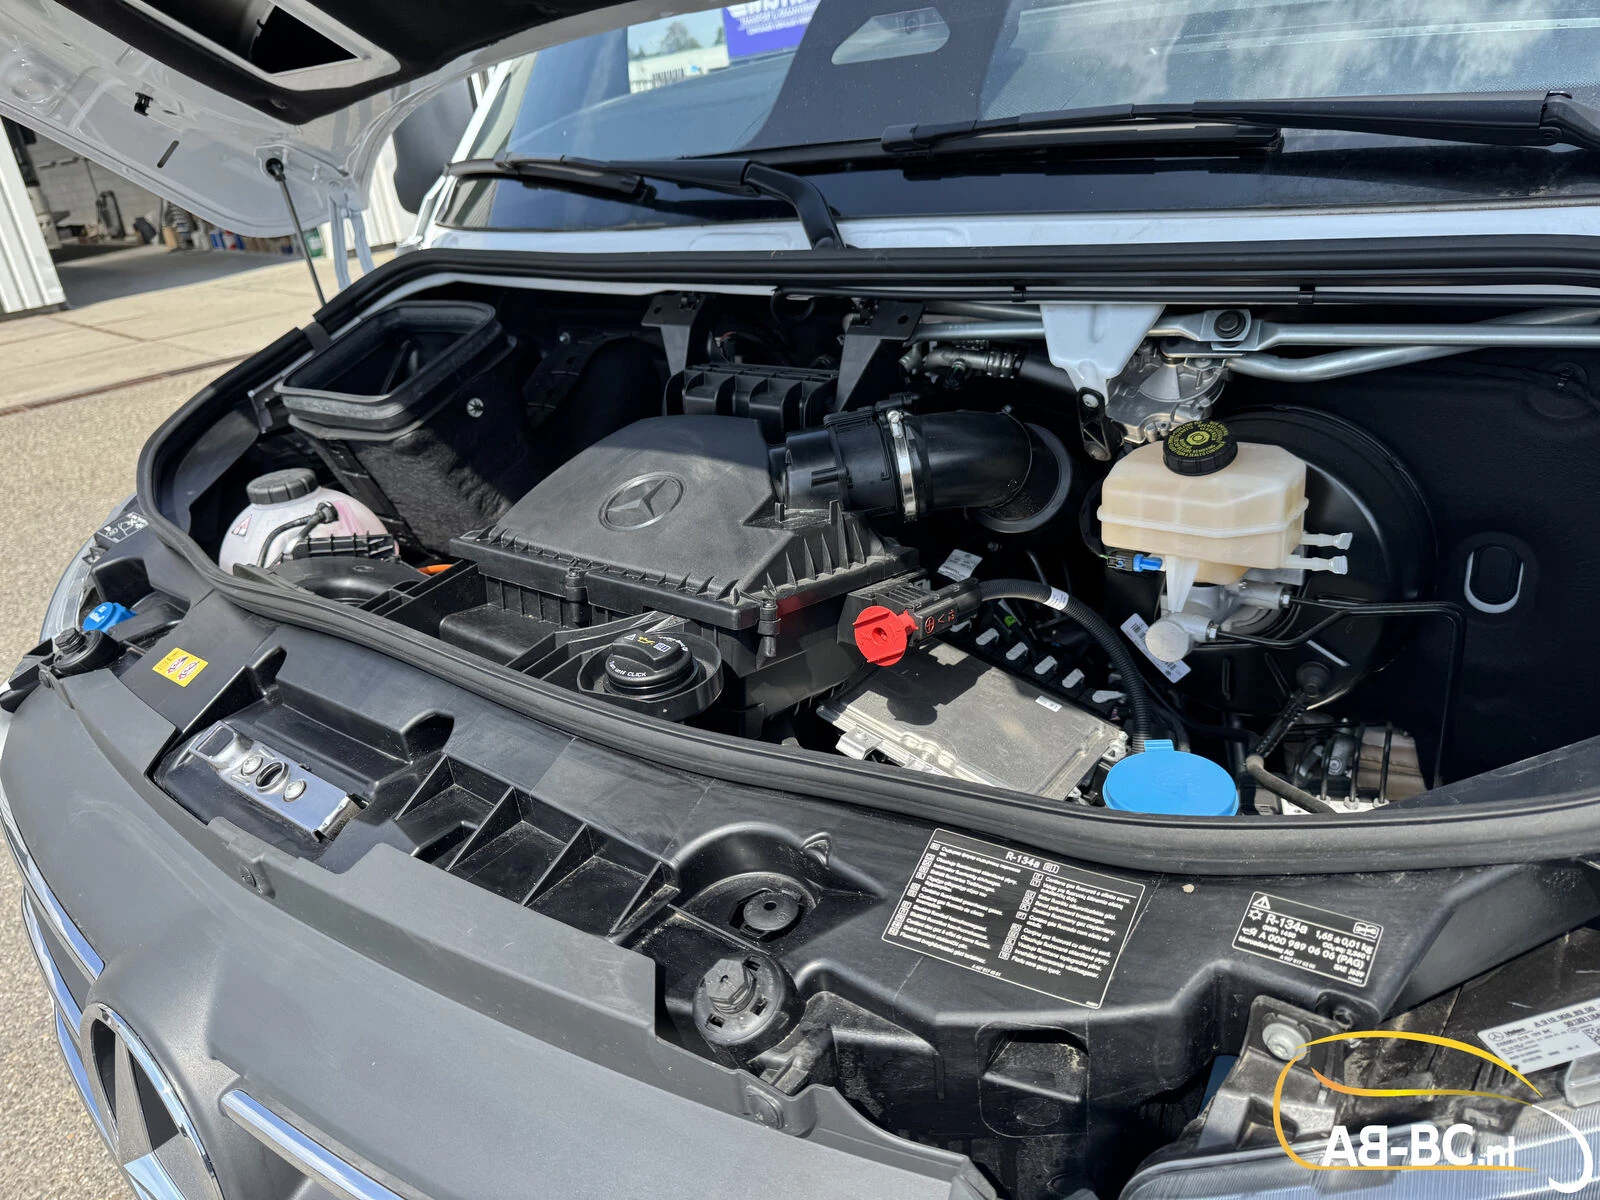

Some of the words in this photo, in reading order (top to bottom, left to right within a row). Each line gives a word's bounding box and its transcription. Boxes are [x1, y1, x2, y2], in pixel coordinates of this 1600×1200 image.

[1005, 851, 1041, 868] R-134a
[1265, 913, 1308, 934] R-134a
[1316, 930, 1334, 942] 1,65
[1341, 937, 1361, 950] 0,01
[1361, 943, 1374, 955] kg
[1258, 932, 1266, 940] A
[1268, 934, 1287, 945] 000
[1288, 940, 1307, 951] 989
[1308, 946, 1321, 955] 06
[1322, 950, 1335, 960] 06
[1337, 954, 1365, 970] (PAG)
[1284, 949, 1295, 957] AG
